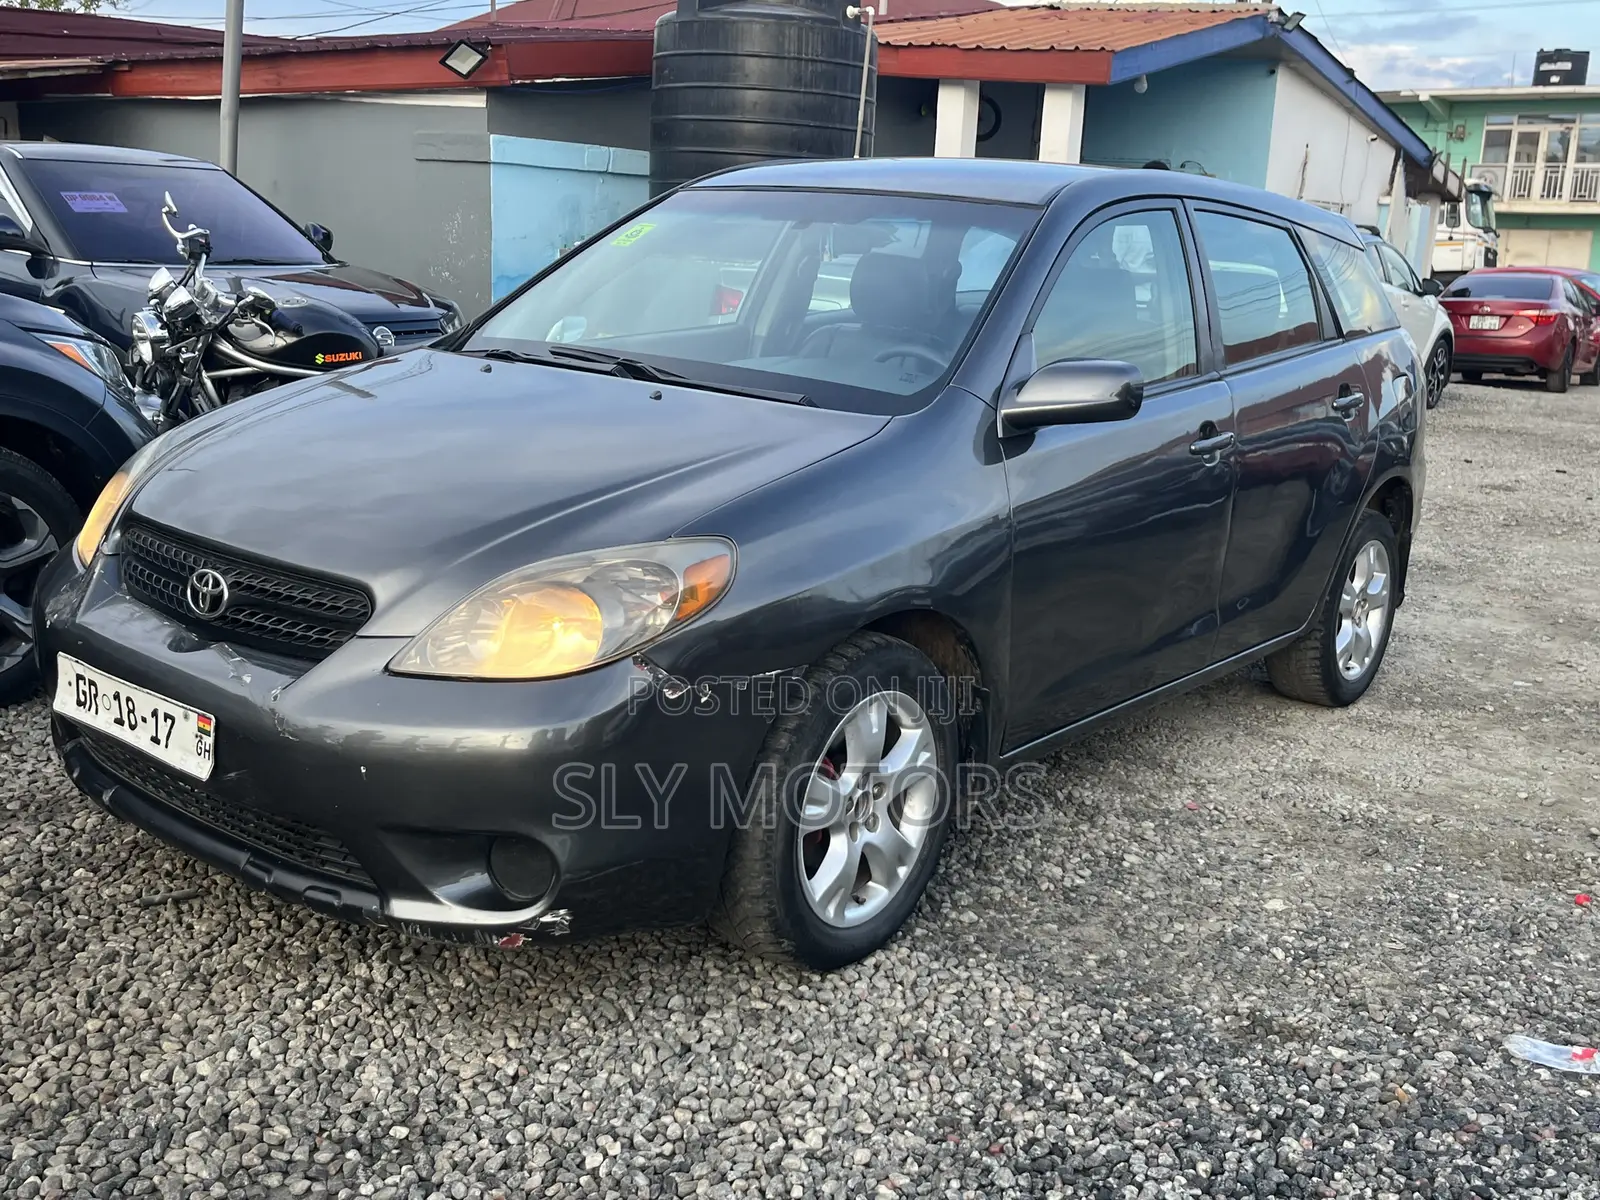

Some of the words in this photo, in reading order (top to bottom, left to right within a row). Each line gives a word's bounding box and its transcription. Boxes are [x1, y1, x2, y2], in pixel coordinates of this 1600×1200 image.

[324, 351, 363, 363] SUZUKI
[75, 673, 99, 716] GR
[113, 690, 176, 749] 18-17
[195, 739, 211, 761] GH
